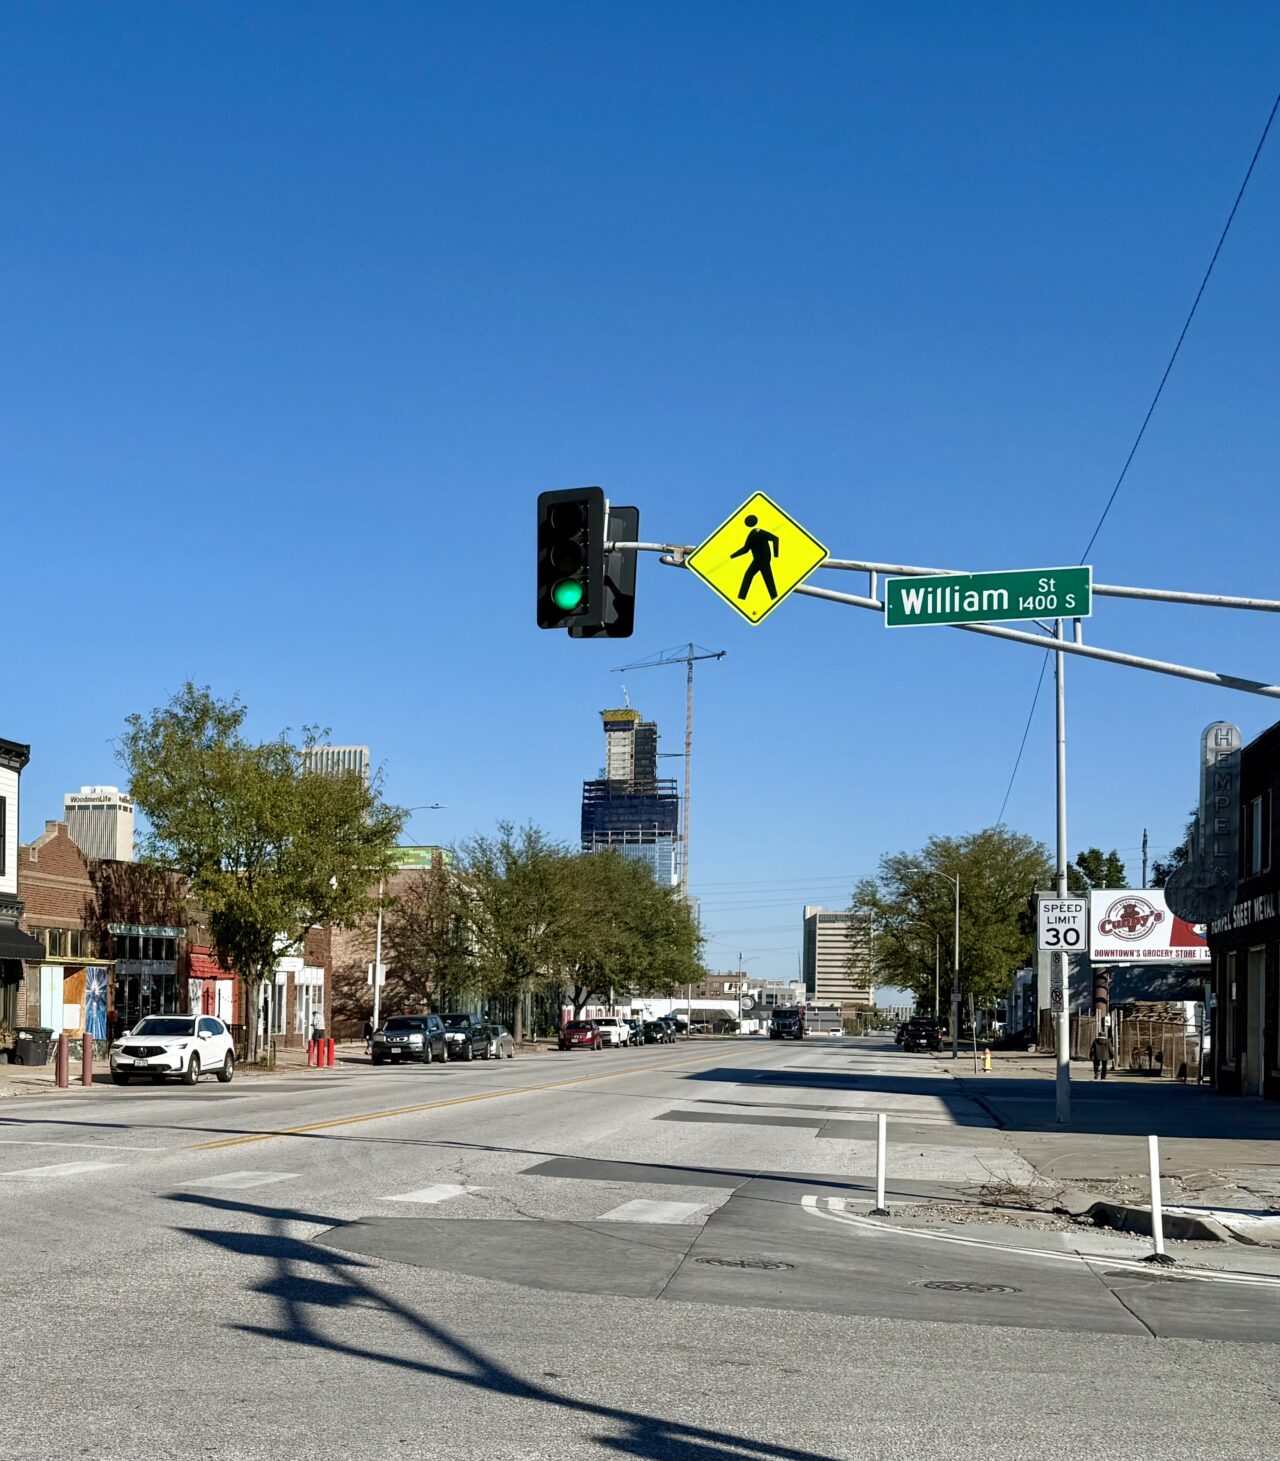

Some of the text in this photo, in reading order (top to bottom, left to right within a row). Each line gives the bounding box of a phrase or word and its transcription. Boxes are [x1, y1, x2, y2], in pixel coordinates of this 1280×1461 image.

[1038, 578, 1056, 592] St
[901, 586, 1008, 615] William
[1018, 594, 1076, 611] 1400 S
[70, 795, 112, 803] WoodmenLife
[1214, 728, 1233, 858] HEMPEL
[1043, 904, 1082, 912] SPEED
[1233, 900, 1252, 928] SHEET
[1254, 893, 1276, 922] METAL
[1047, 916, 1078, 924] LIMIT
[1100, 910, 1163, 935] Cubby's
[1045, 928, 1080, 946] 30
[1094, 949, 1140, 958] DOWNTOWN'S
[1143, 949, 1173, 958] GROCERY
[1176, 949, 1196, 958] STORE
